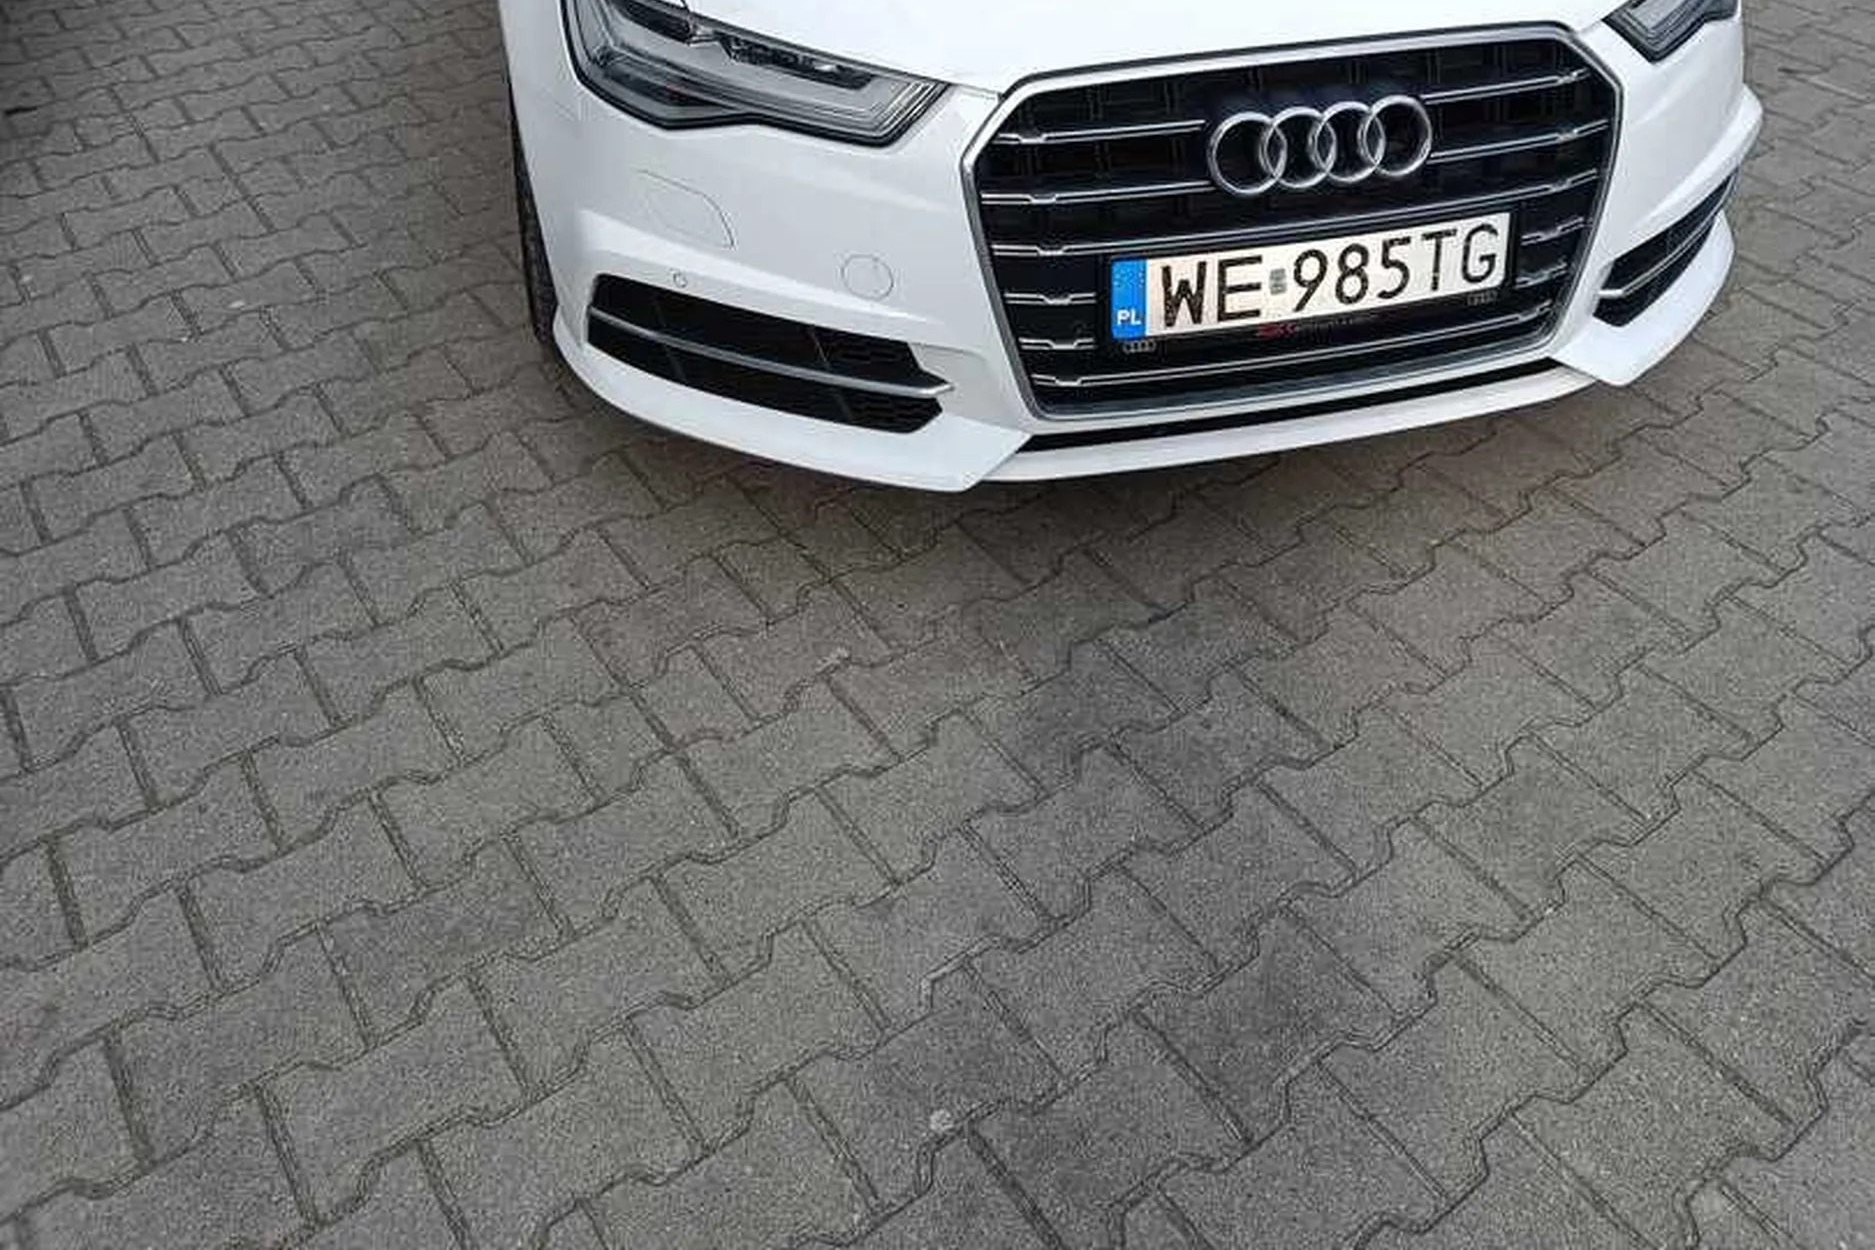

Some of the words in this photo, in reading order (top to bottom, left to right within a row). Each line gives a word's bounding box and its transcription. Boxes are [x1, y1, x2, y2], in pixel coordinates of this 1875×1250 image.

[1161, 255, 1263, 328] WE
[1293, 222, 1499, 312] 985TG
[1116, 309, 1142, 326] PL
